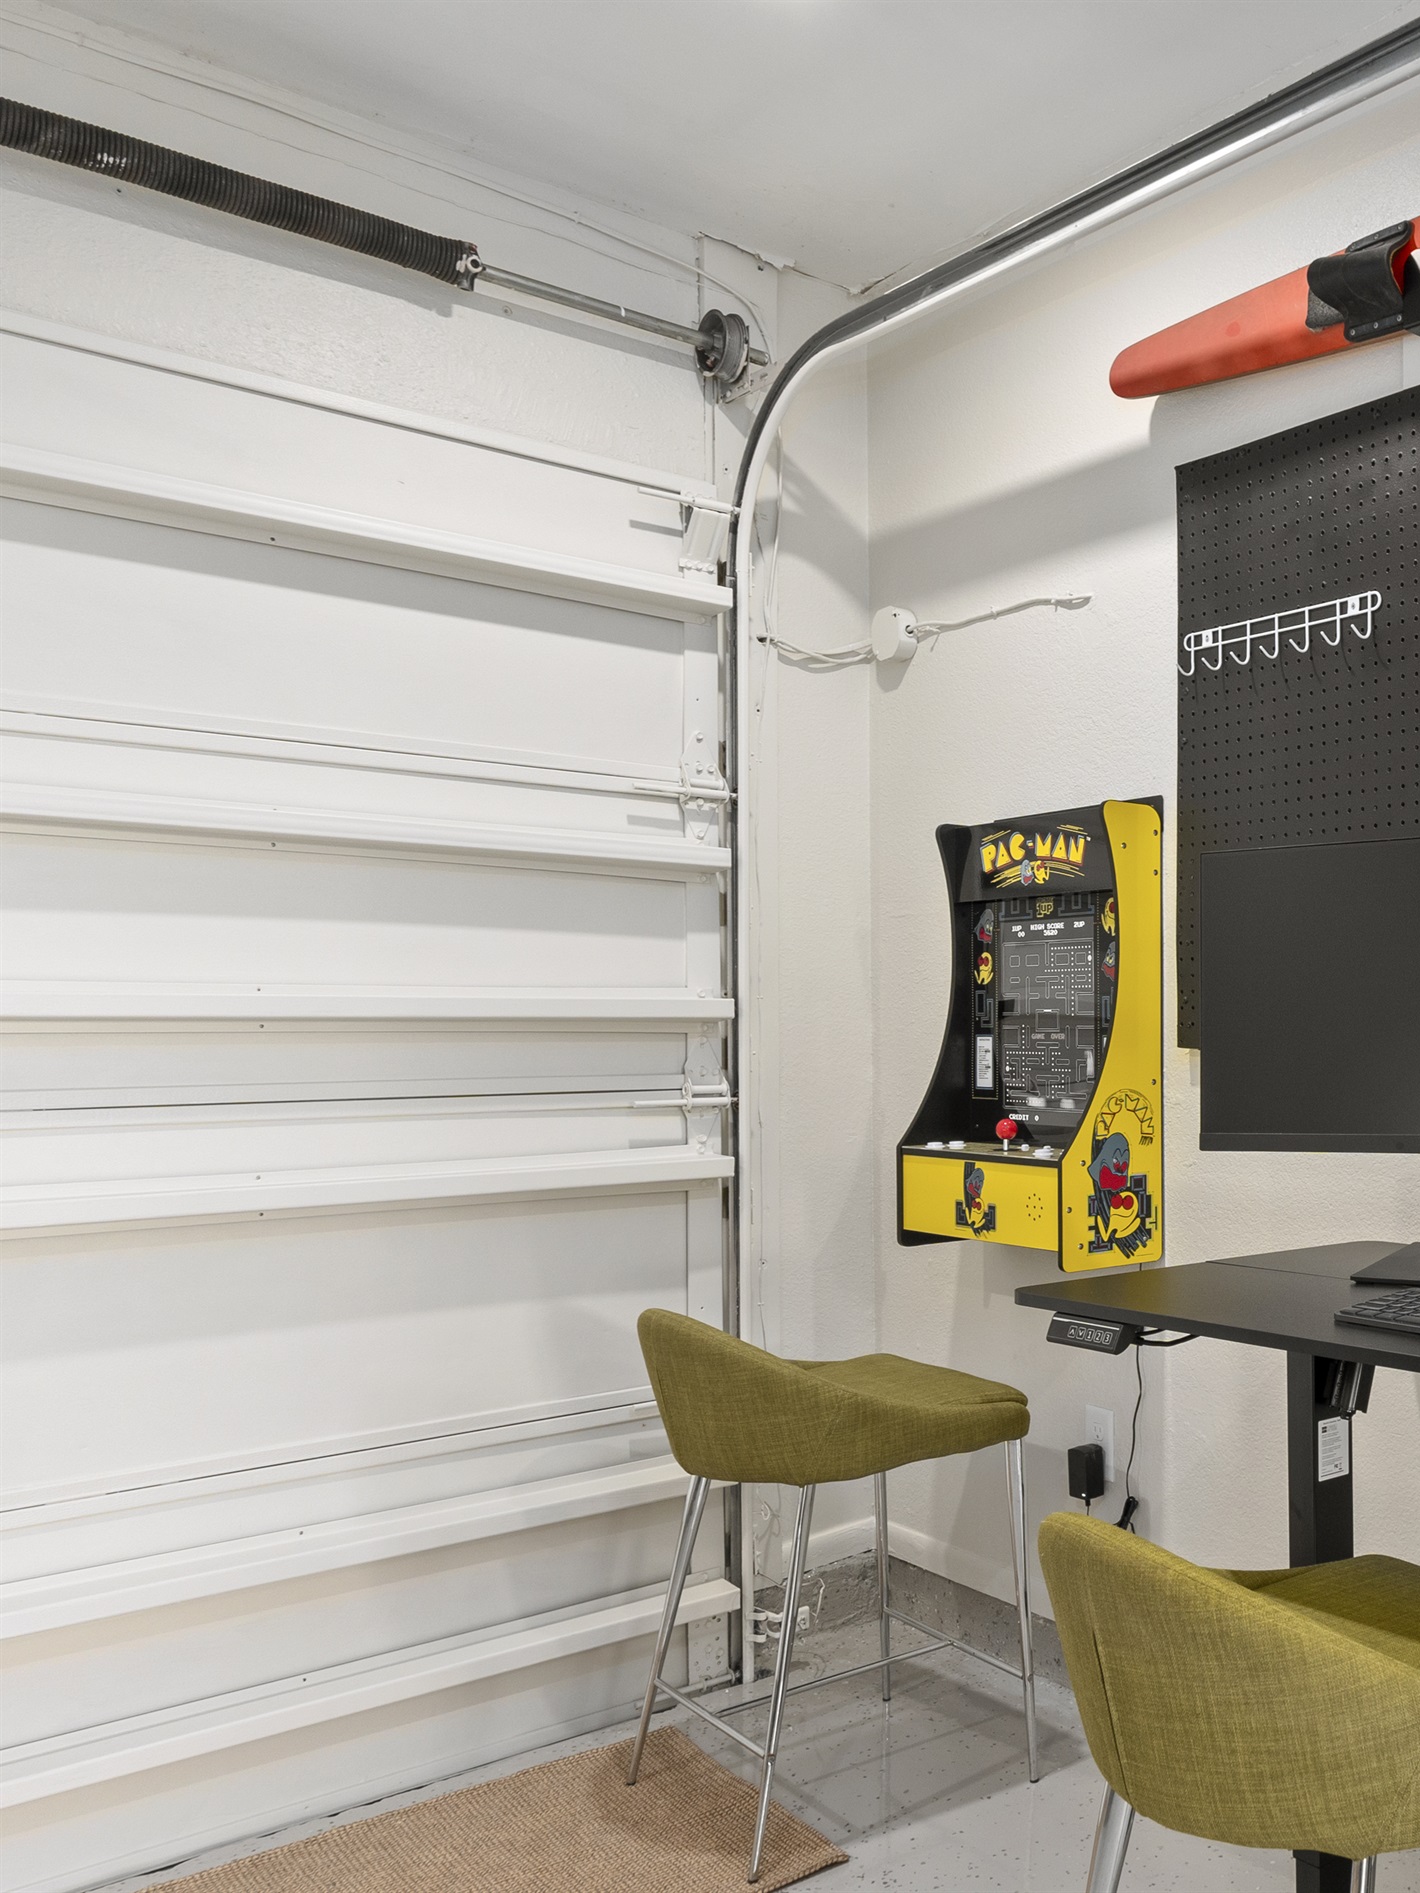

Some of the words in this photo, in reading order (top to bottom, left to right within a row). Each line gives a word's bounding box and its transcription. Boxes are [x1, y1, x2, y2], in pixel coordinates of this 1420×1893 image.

[980, 832, 1086, 874] PAC-MAN
[1030, 923, 1045, 931] HIGH
[1046, 922, 1065, 930] SCORE
[1008, 1113, 1029, 1121] CREDIT
[1096, 1093, 1155, 1137] PAC-MAN
